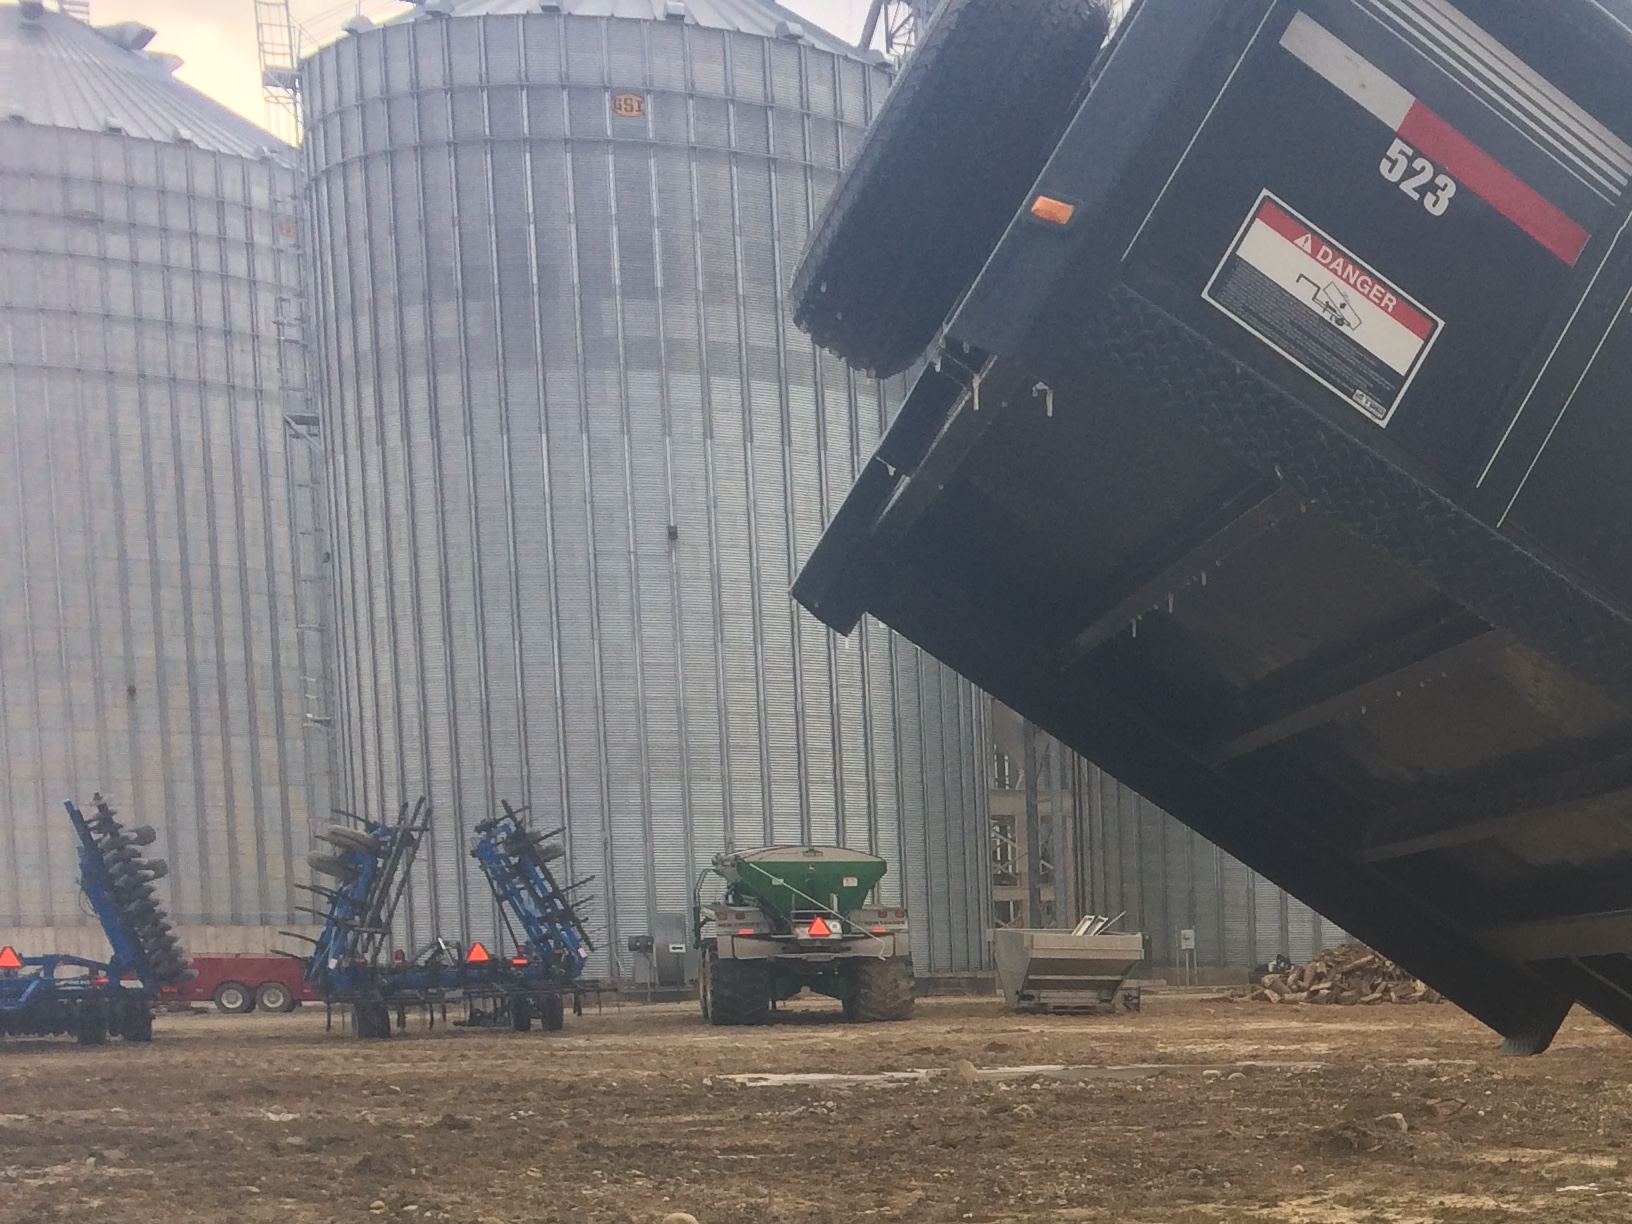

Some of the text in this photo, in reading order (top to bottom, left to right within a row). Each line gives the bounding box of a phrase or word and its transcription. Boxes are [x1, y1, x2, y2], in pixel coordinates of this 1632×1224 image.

[613, 97, 645, 113] GSI
[1379, 137, 1457, 217] 523
[1316, 245, 1397, 313] DANGER
